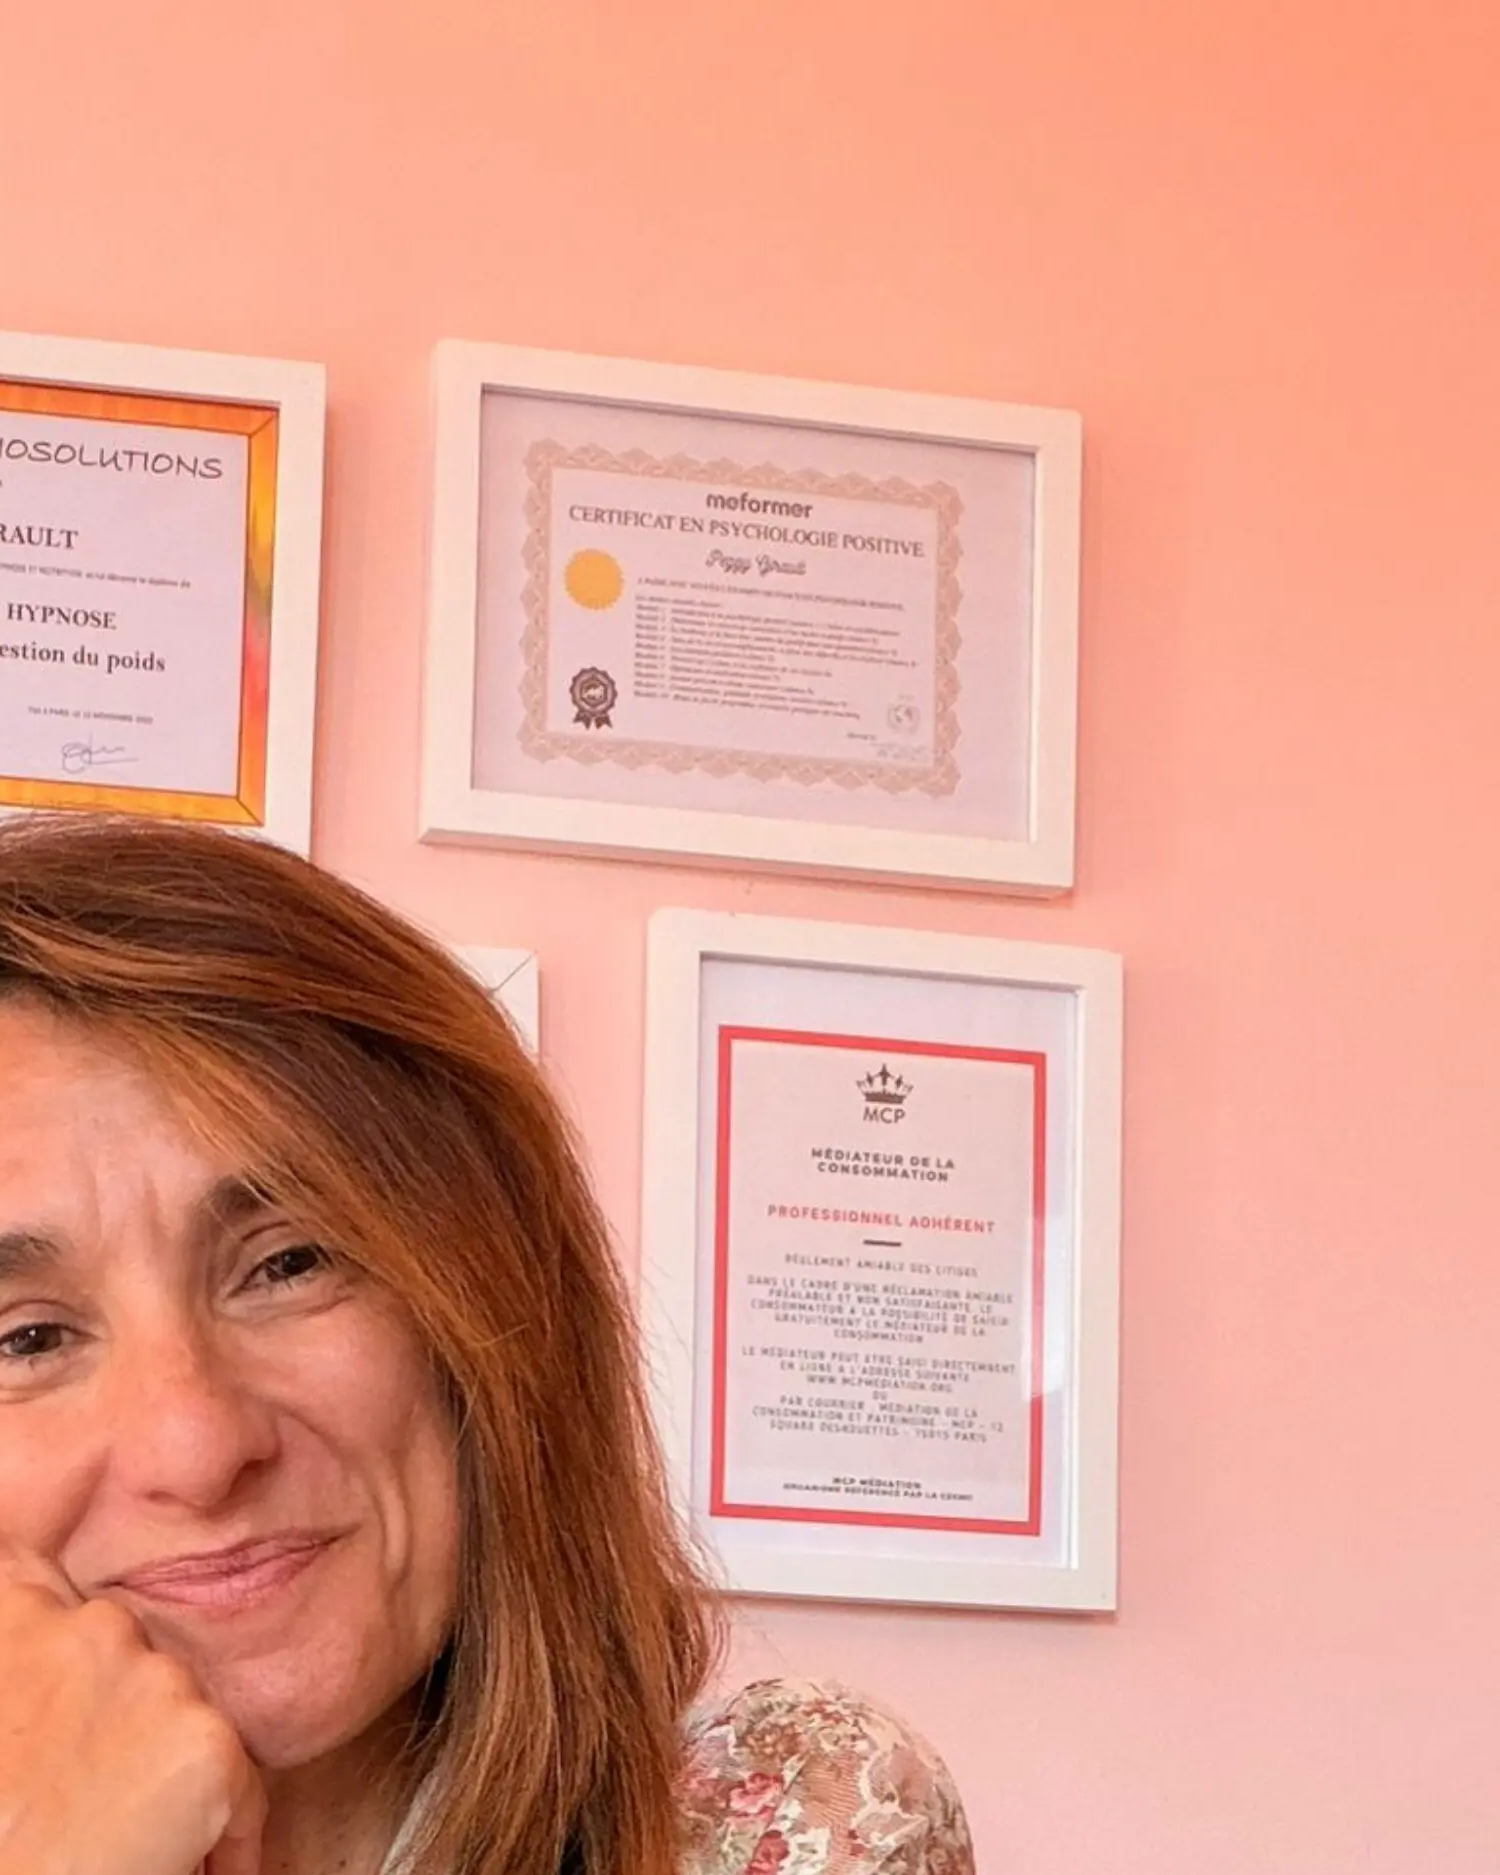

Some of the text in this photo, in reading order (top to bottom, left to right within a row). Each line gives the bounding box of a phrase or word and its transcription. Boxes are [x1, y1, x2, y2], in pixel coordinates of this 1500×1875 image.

[569, 505, 924, 558] CERTIFICAT EN PSYCHOLOGIE POSITIVE
[7, 602, 117, 630] HYPNOSE
[72, 646, 99, 666] du
[106, 651, 166, 674] poids
[863, 1107, 906, 1124] MCP
[811, 1147, 955, 1169] MÉDIATEUR DE LA
[818, 1162, 949, 1182] CONSOMMATION
[767, 1204, 996, 1233] PROFESSIONNEL ADHÉRENT
